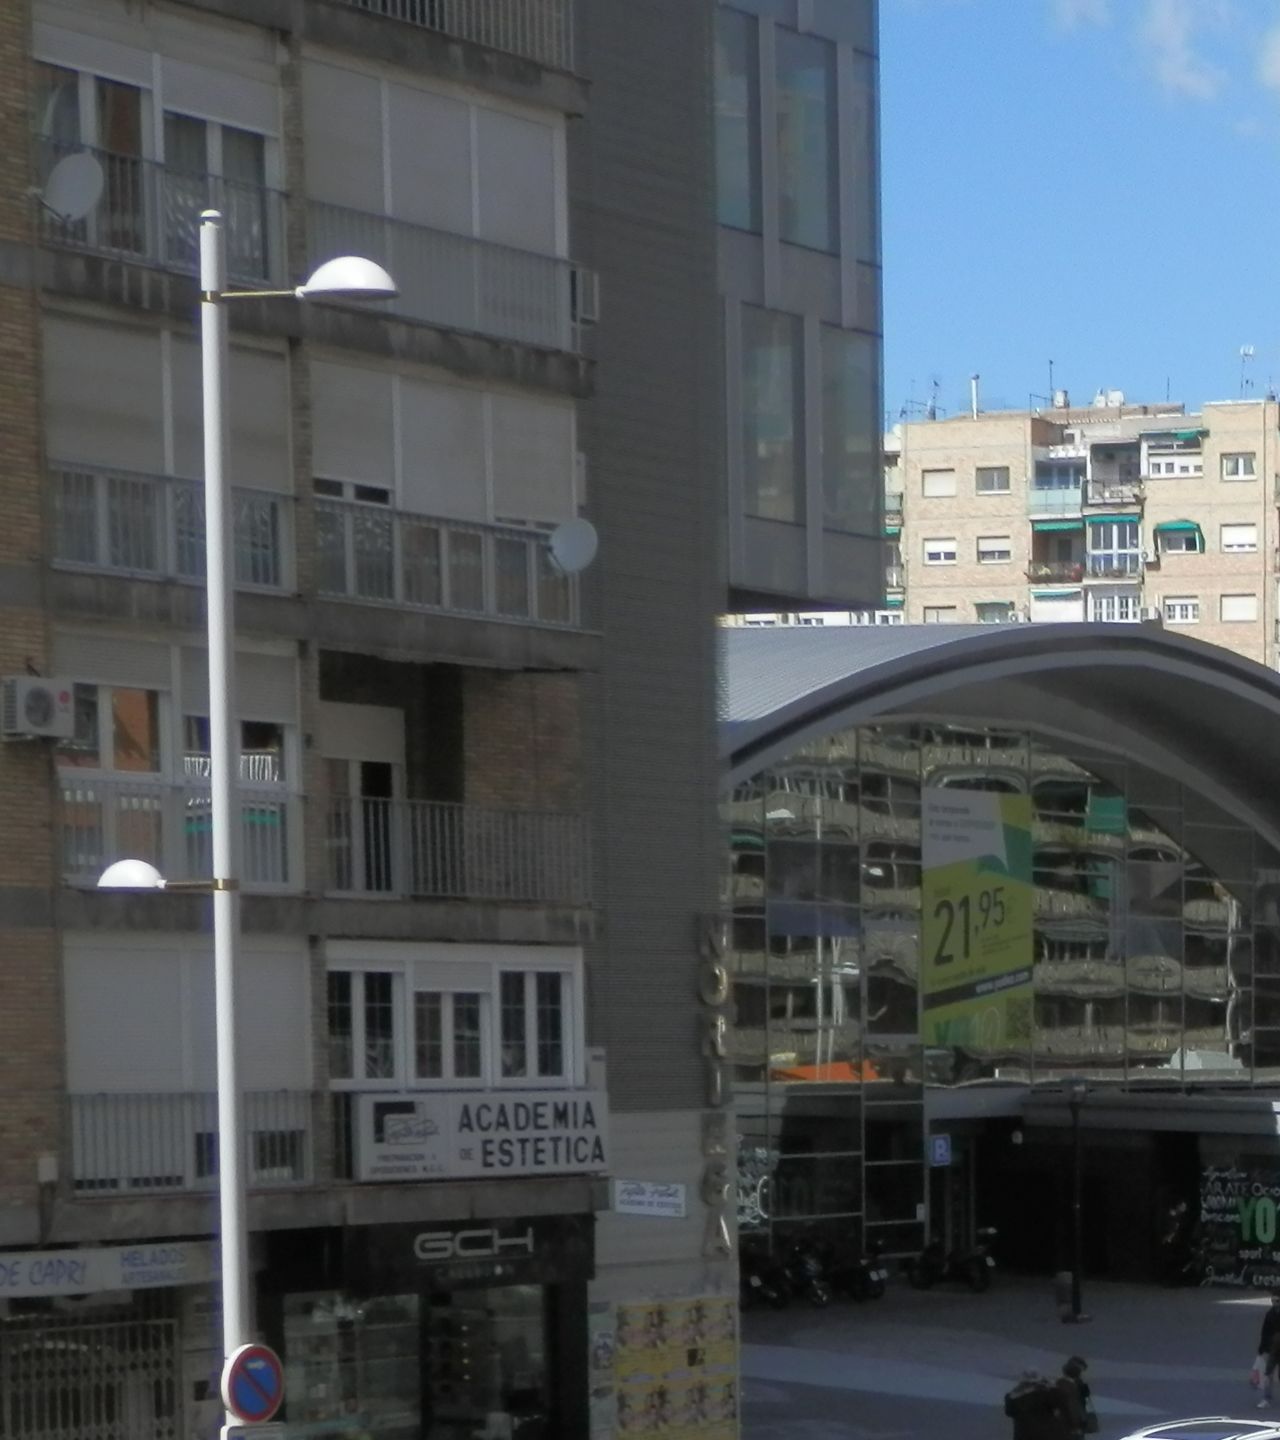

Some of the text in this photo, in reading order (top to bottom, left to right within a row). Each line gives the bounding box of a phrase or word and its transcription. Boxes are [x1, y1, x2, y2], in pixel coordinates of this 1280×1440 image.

[458, 1101, 597, 1133] ACADEMIA
[460, 1135, 607, 1168] DE ESTETICA
[414, 1227, 534, 1260] GCH
[28, 1258, 87, 1287] CAPRI
